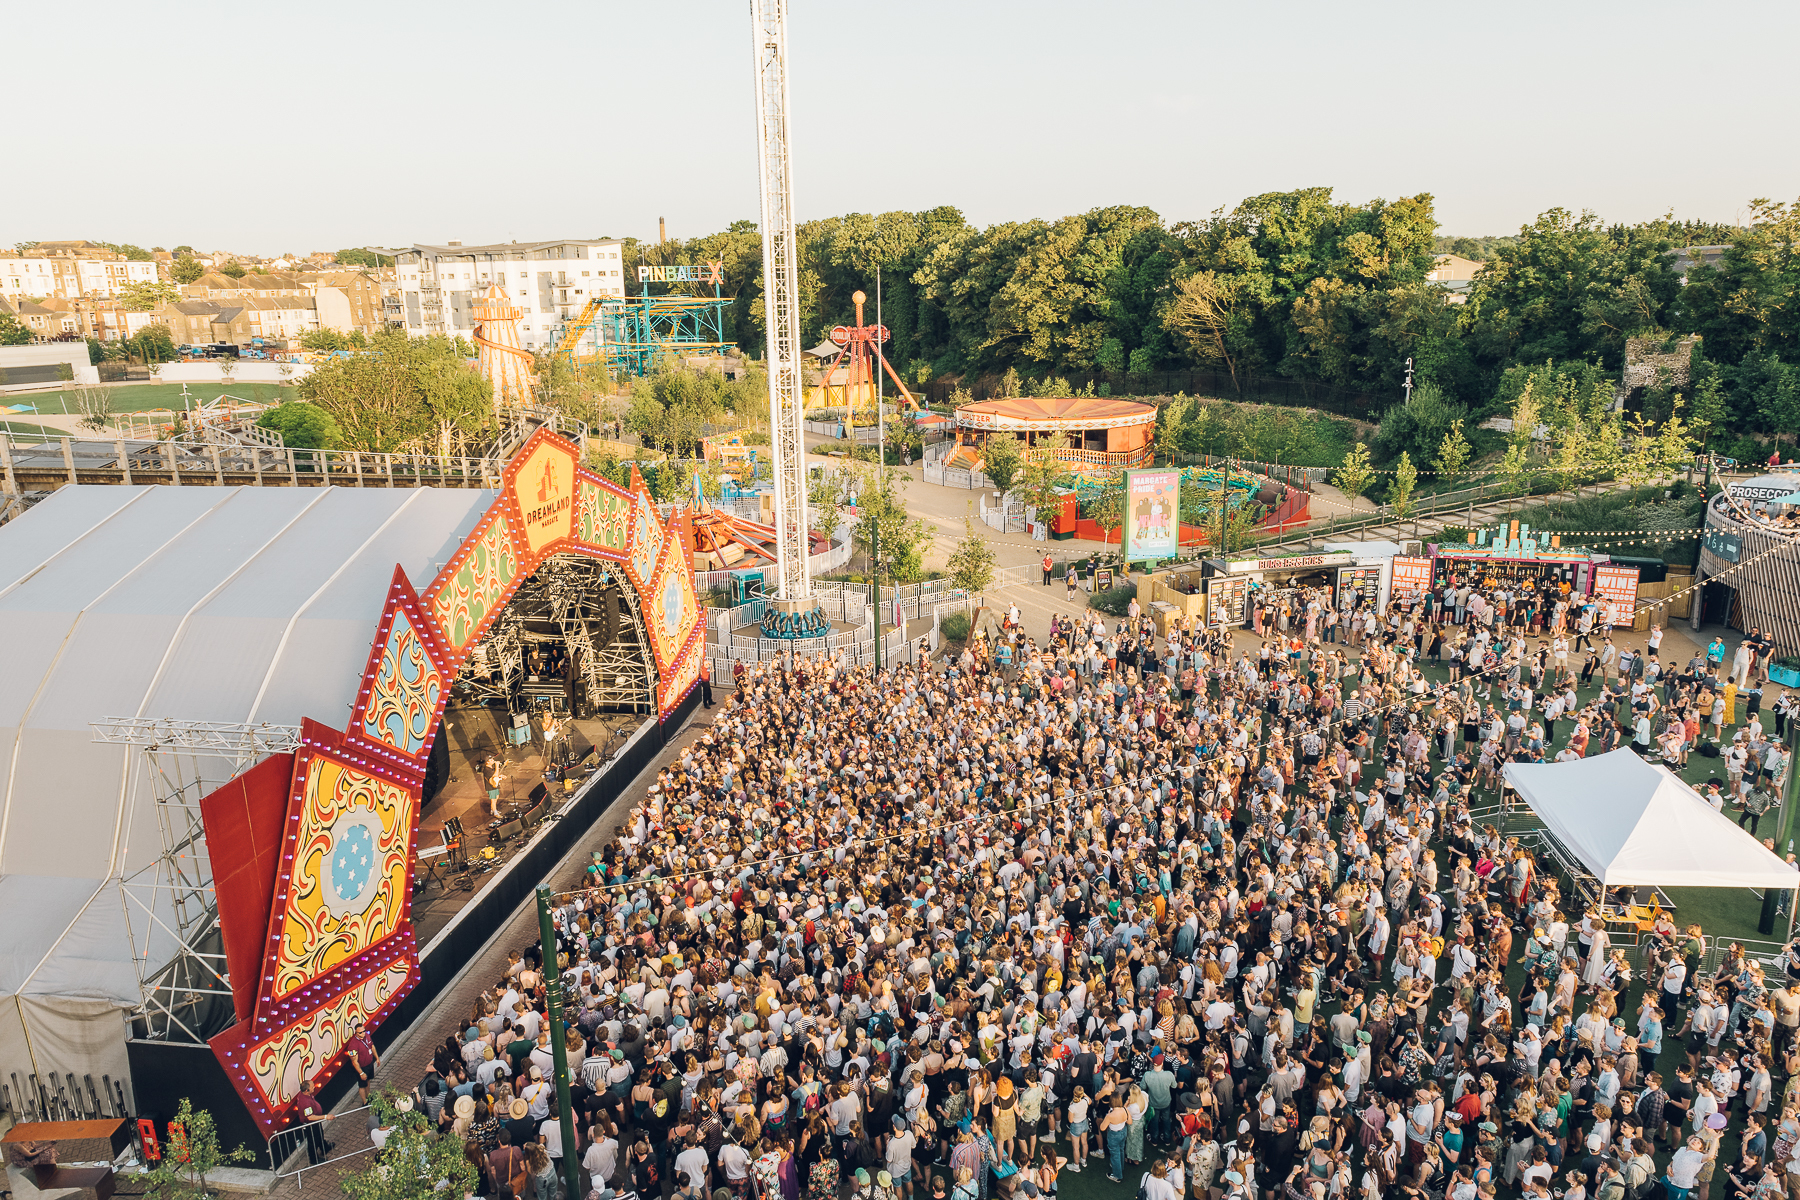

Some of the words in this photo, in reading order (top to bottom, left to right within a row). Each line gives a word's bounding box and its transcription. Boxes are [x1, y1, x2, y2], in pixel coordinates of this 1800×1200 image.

[638, 265, 708, 282] PINBALL
[707, 261, 724, 285] X
[962, 412, 991, 423] WALTZER
[1133, 476, 1168, 485] MARGATE
[1133, 485, 1155, 493] PRIDE
[1730, 487, 1790, 499] PROSECCO
[527, 496, 569, 526] DREAMLAND
[542, 515, 558, 528] MARGATE
[1492, 537, 1537, 559] BAR
[1259, 557, 1295, 569] BURGERS
[1295, 556, 1302, 567] &
[1303, 555, 1324, 566] DOGS
[1394, 565, 1430, 578] WINE
[1393, 581, 1428, 589] PROSECO
[1597, 576, 1637, 589] WINE
